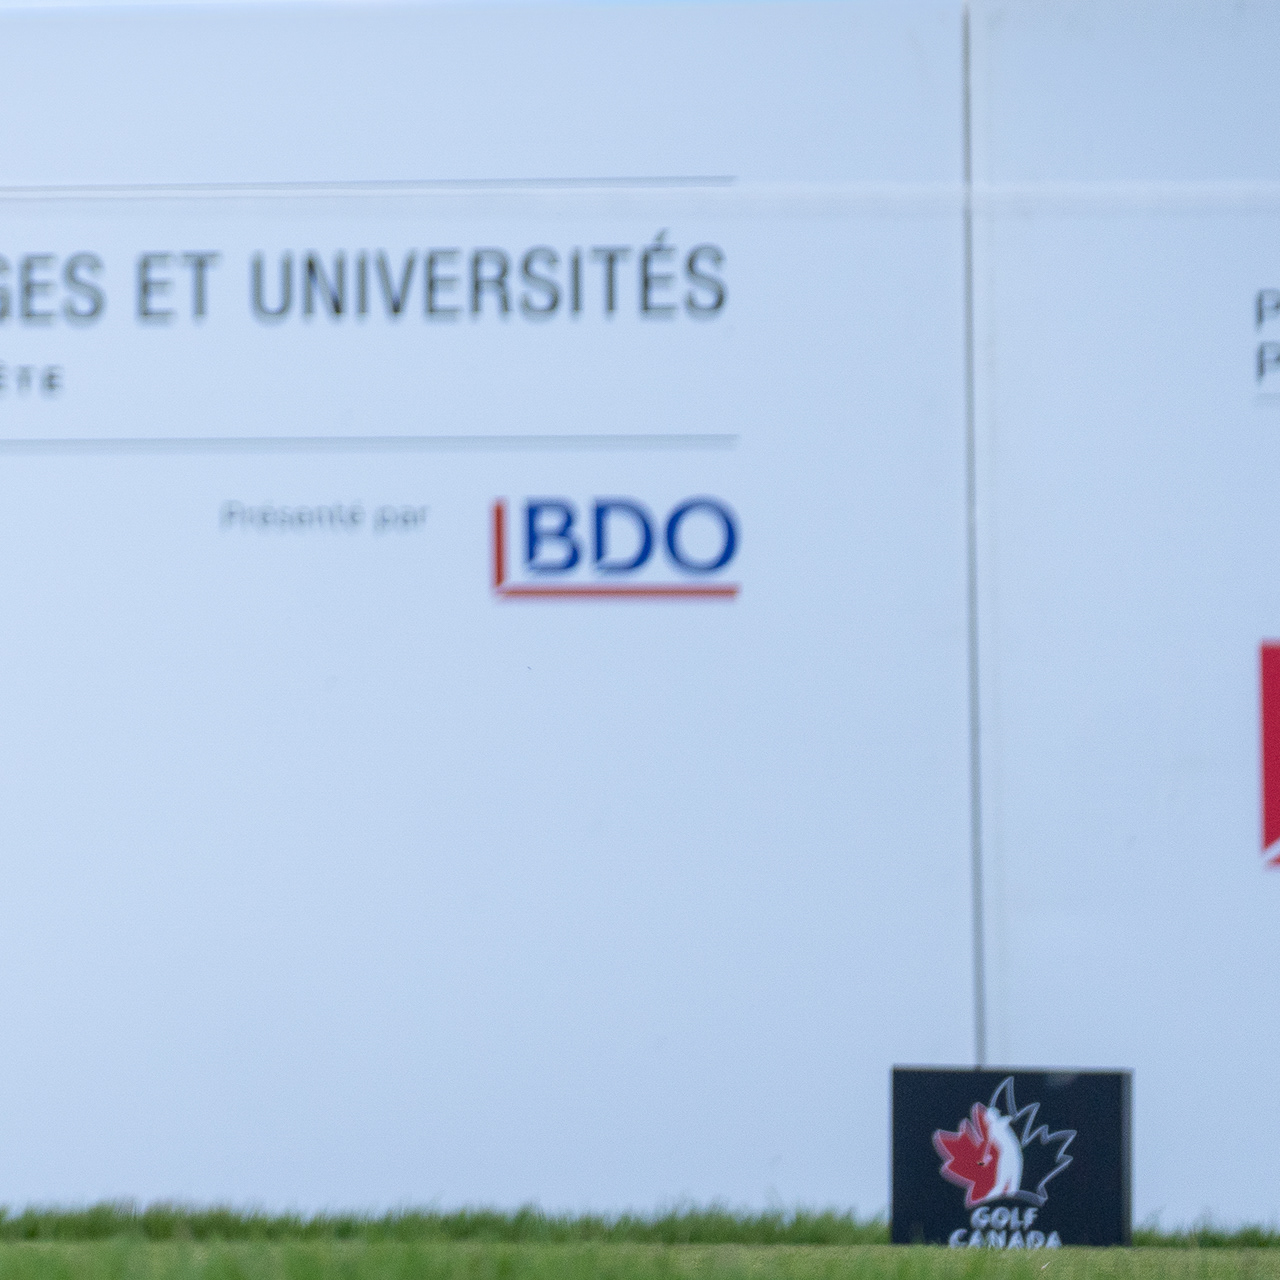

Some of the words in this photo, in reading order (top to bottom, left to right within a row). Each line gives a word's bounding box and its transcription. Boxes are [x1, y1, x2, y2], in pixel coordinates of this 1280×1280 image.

[135, 250, 224, 325] ET
[248, 229, 730, 325] UNIVERSITÉS
[522, 495, 742, 577] BDO
[969, 1206, 1039, 1229] GOLF
